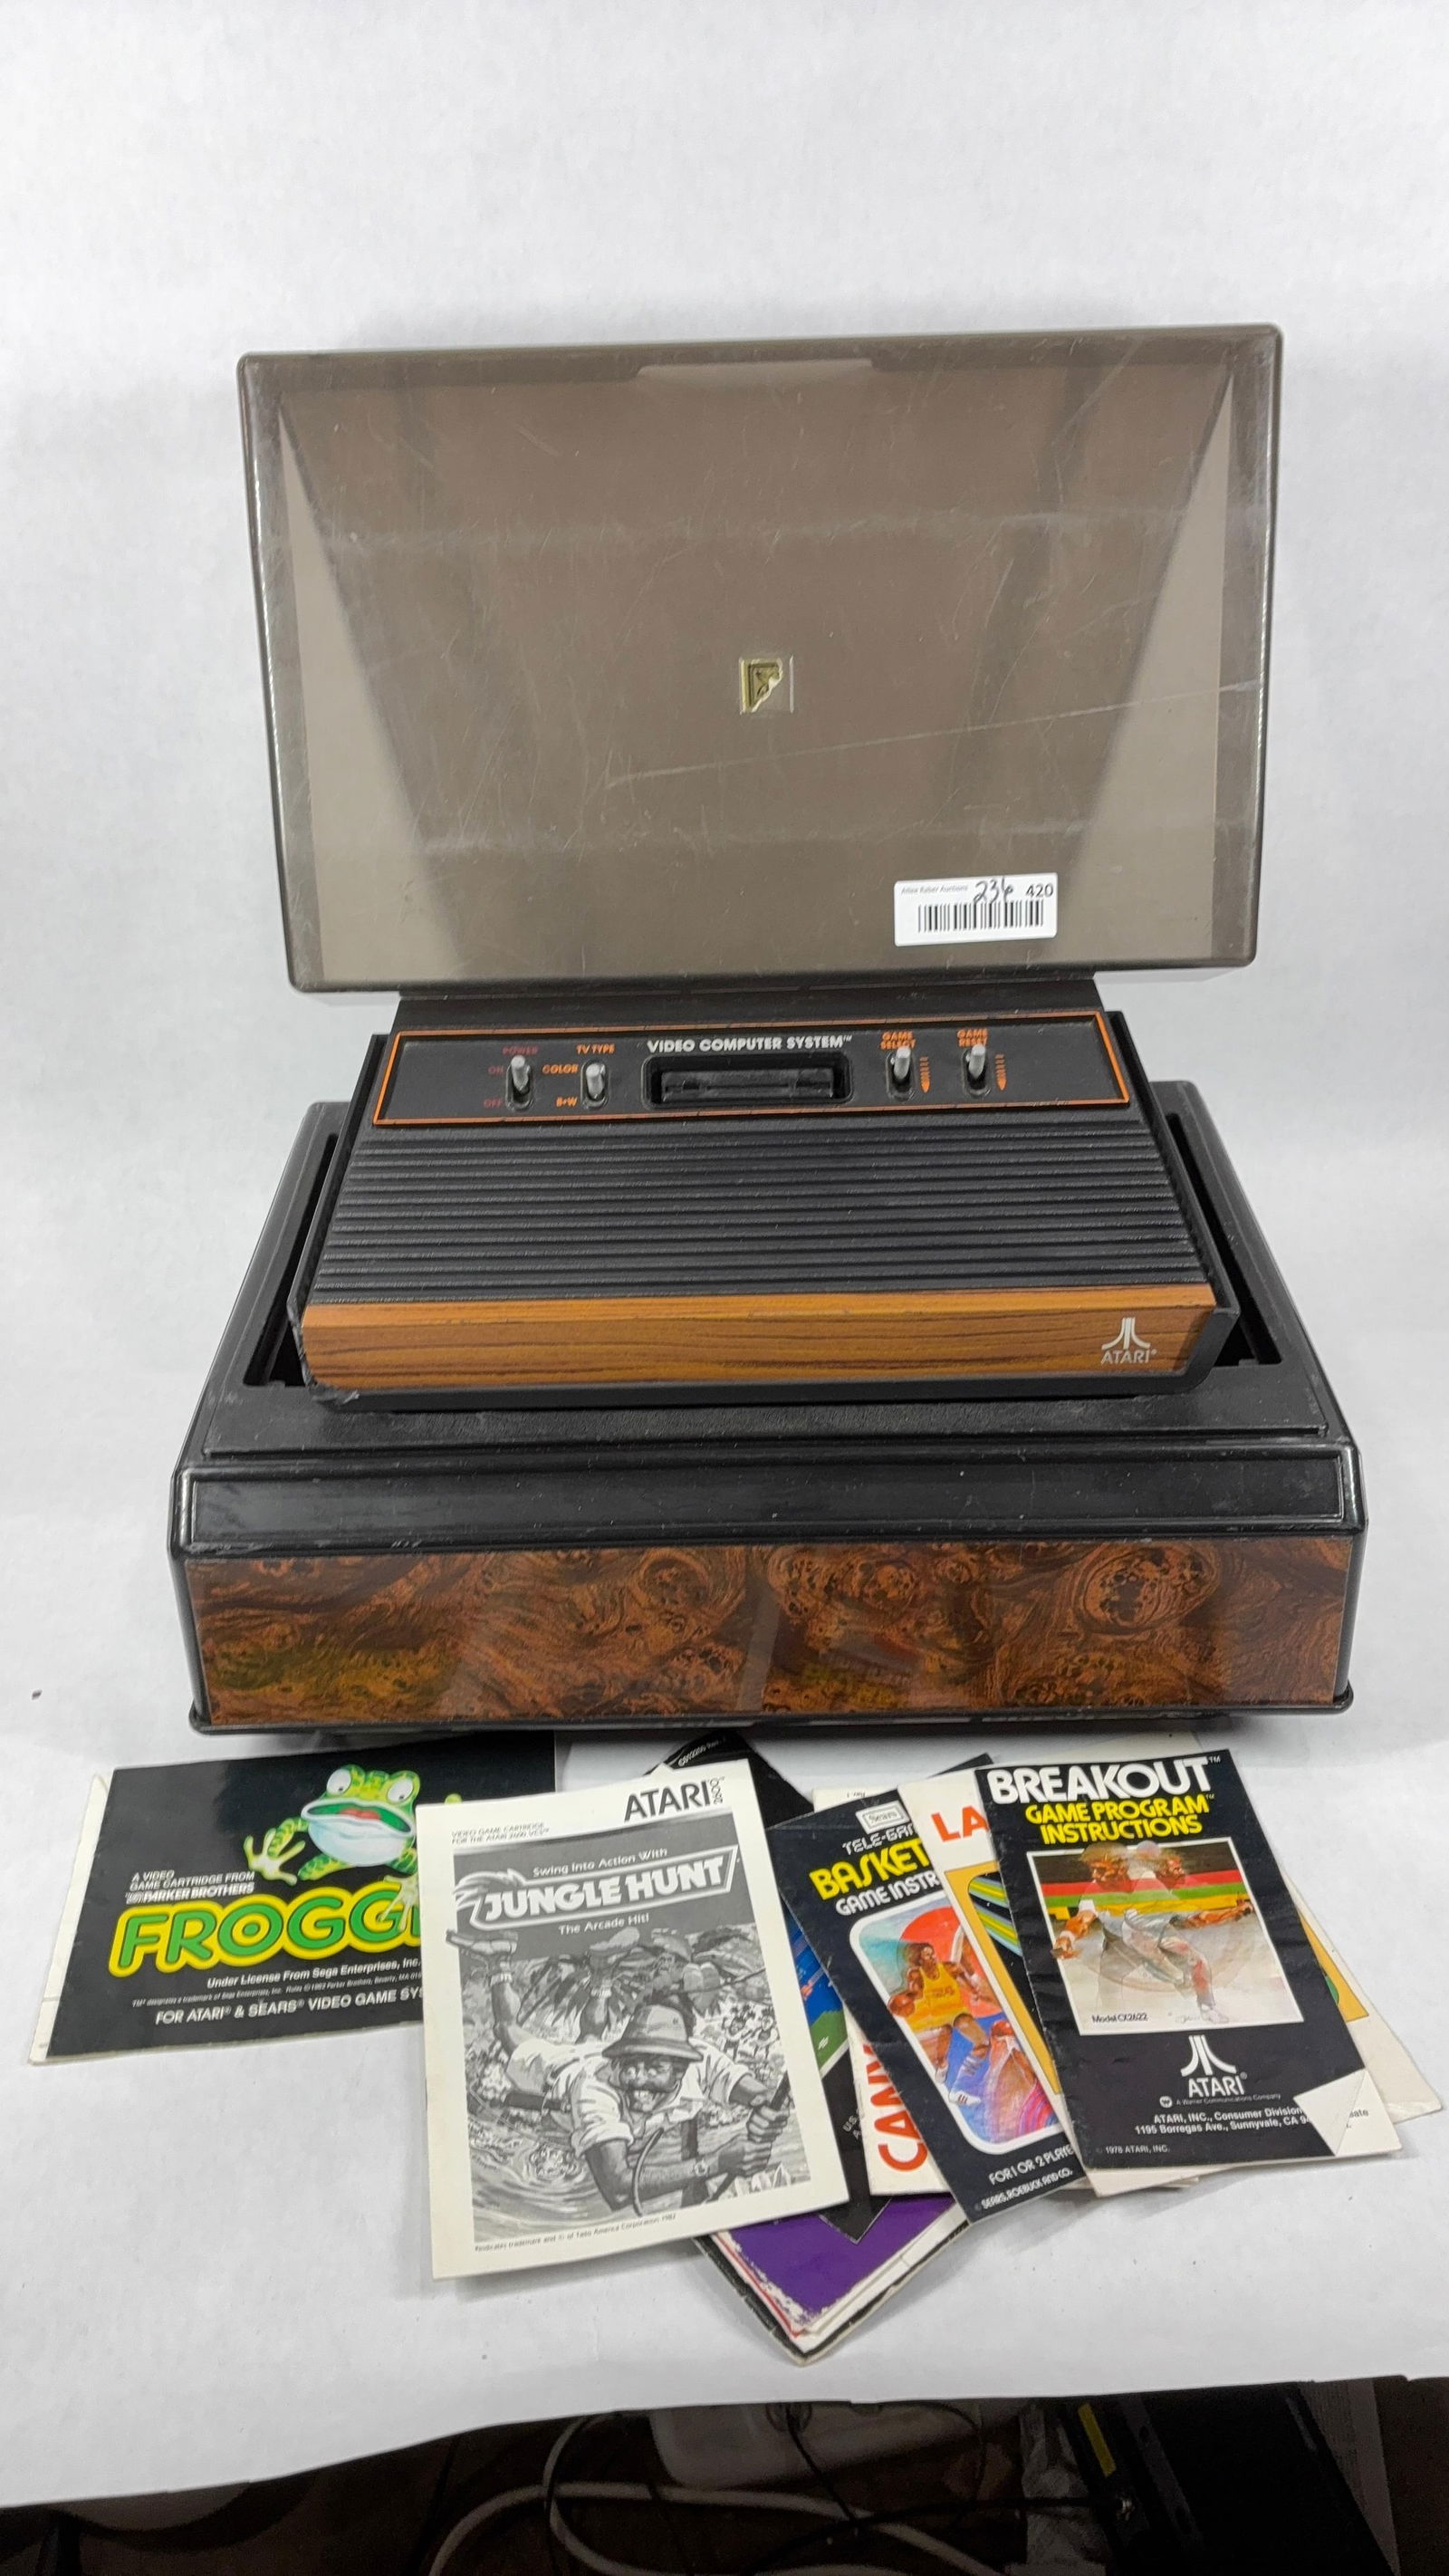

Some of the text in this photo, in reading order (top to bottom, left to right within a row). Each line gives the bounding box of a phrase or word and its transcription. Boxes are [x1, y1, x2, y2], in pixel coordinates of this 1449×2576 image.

[1025, 882, 1054, 899] 420
[647, 1039, 696, 1053] VIDEO
[699, 1037, 782, 1052] COMPUTER
[882, 1031, 914, 1041] GAME
[957, 1028, 988, 1039] GAME
[503, 1045, 539, 1055] POWER
[576, 1043, 615, 1054] TV TYPE
[542, 1063, 579, 1074] COLOR
[623, 1780, 712, 1822] ATARI
[931, 1805, 991, 1842] LA
[1025, 1802, 1089, 1825] GAME
[1040, 1814, 1204, 1845] INSTRUCTIONS
[533, 1848, 667, 1878] Swing Into Action With
[809, 1837, 930, 1900] BASKET
[130, 1870, 255, 1891] GAME CARTRIDGE FROM
[131, 1870, 175, 1882] A VIDEO
[485, 1854, 724, 1921] JUNGLE HUNT
[143, 1881, 255, 1903] PARKER BROTHERS
[835, 1870, 942, 1917] GAME INSTR
[109, 1881, 423, 1978] FROGG
[558, 1912, 650, 1936] The Arcade Hit!
[206, 1976, 239, 1989] Under
[240, 1973, 281, 1985] License
[283, 1969, 311, 1982] From
[312, 1966, 339, 1979] Sega
[341, 1959, 400, 1975] Enterprises,
[155, 2009, 185, 2025] FOR
[234, 2004, 245, 2019] &
[308, 1994, 352, 2012] VIDEO
[355, 1988, 397, 2006] GAME
[1135, 2124, 1157, 2135] 1195
[1159, 2123, 1203, 2135] Borregas
[1229, 2118, 1282, 2130] Sunnyvale,
[1283, 2115, 1299, 2127] CA
[1154, 2113, 1187, 2124] ATARI,
[1214, 2110, 1262, 2121] Consumer
[1264, 2106, 1304, 2118] Division
[988, 2167, 1014, 2186] FOR
[1017, 2158, 1036, 2174] OR
[1034, 2155, 1046, 2167] 2
[1042, 2143, 1075, 2165] PLAYE
